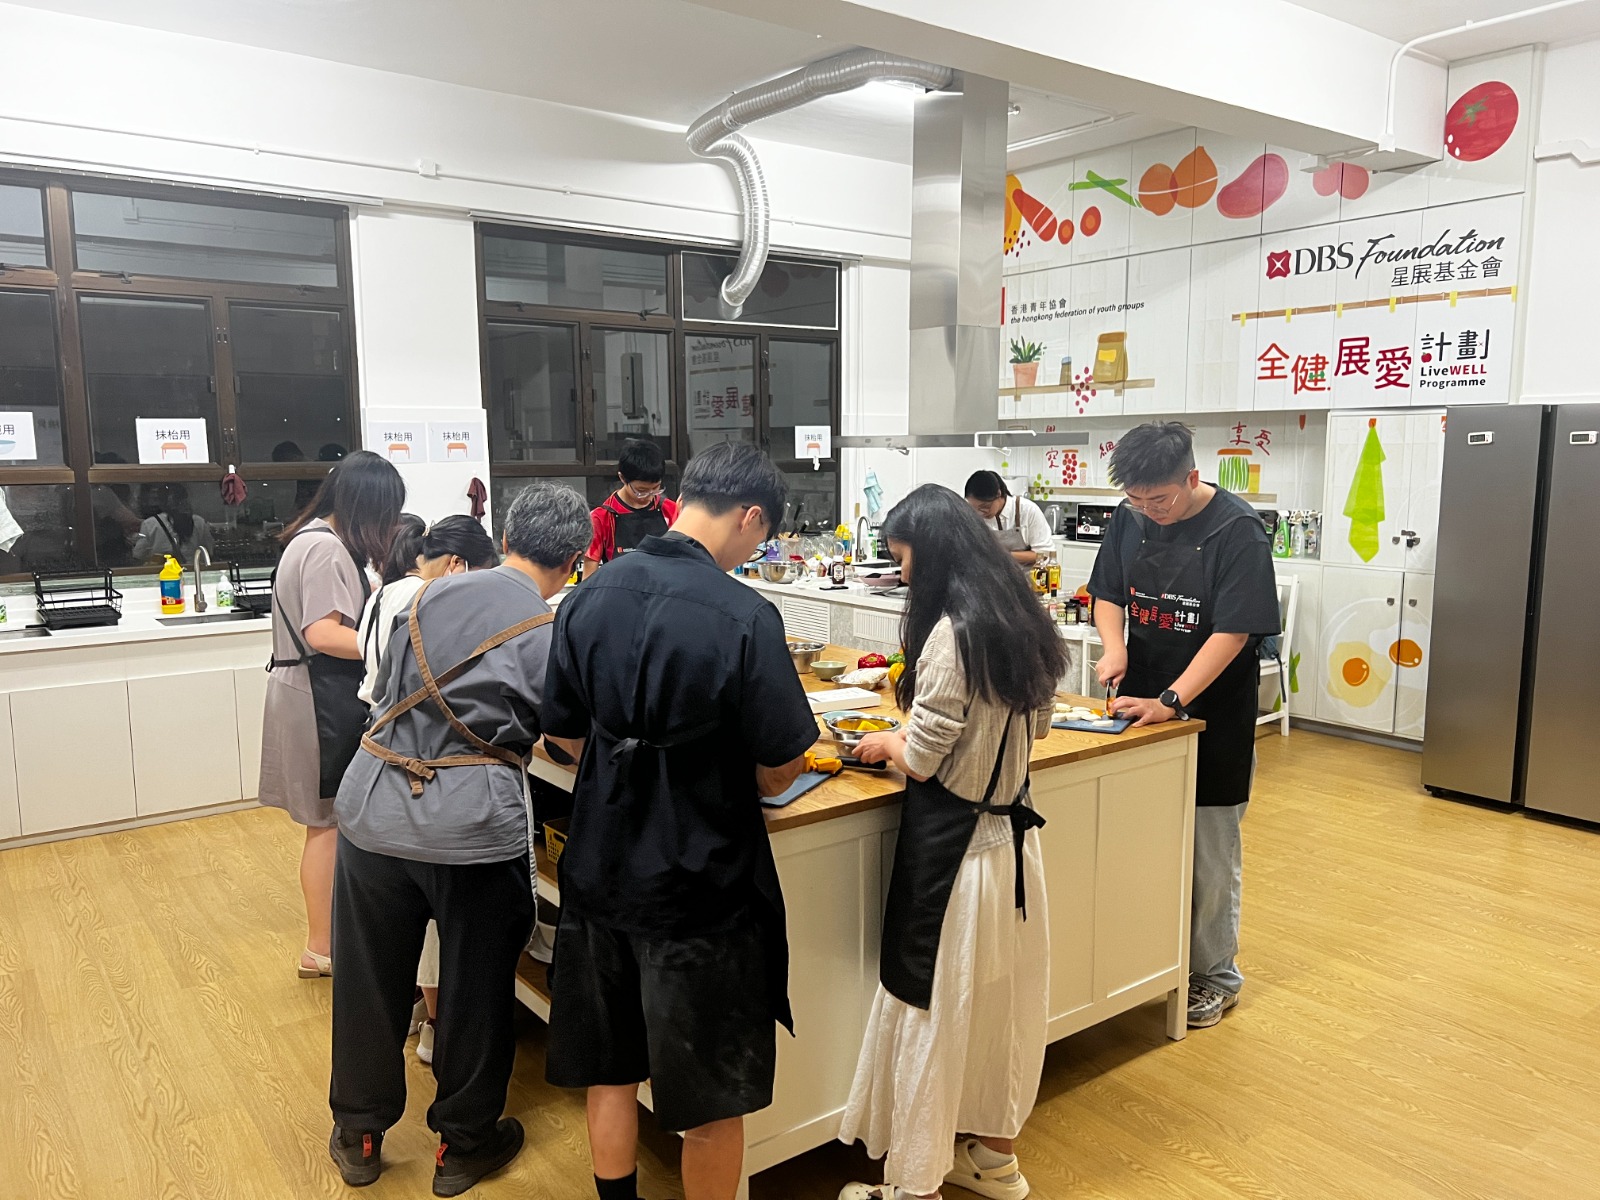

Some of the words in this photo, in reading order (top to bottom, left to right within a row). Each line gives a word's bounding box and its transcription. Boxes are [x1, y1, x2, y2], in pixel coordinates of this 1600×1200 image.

[1294, 241, 1354, 276] DBS
[1355, 228, 1505, 280] Foundation
[1390, 256, 1503, 288] 星展基金會
[1010, 315, 1021, 325] the
[1022, 312, 1053, 323] hongkong
[1054, 308, 1087, 319] federation
[1088, 305, 1096, 315] of
[1097, 303, 1117, 314] youth
[1117, 301, 1145, 313] groups
[1011, 298, 1067, 315] 香港青年協會
[1420, 363, 1487, 377] LiveWELL
[1419, 377, 1486, 389] Programme
[0, 424, 15, 435] 用
[155, 429, 191, 441] 抹枱用
[442, 431, 470, 441] 抹枱用
[383, 432, 413, 442] 抹枱用
